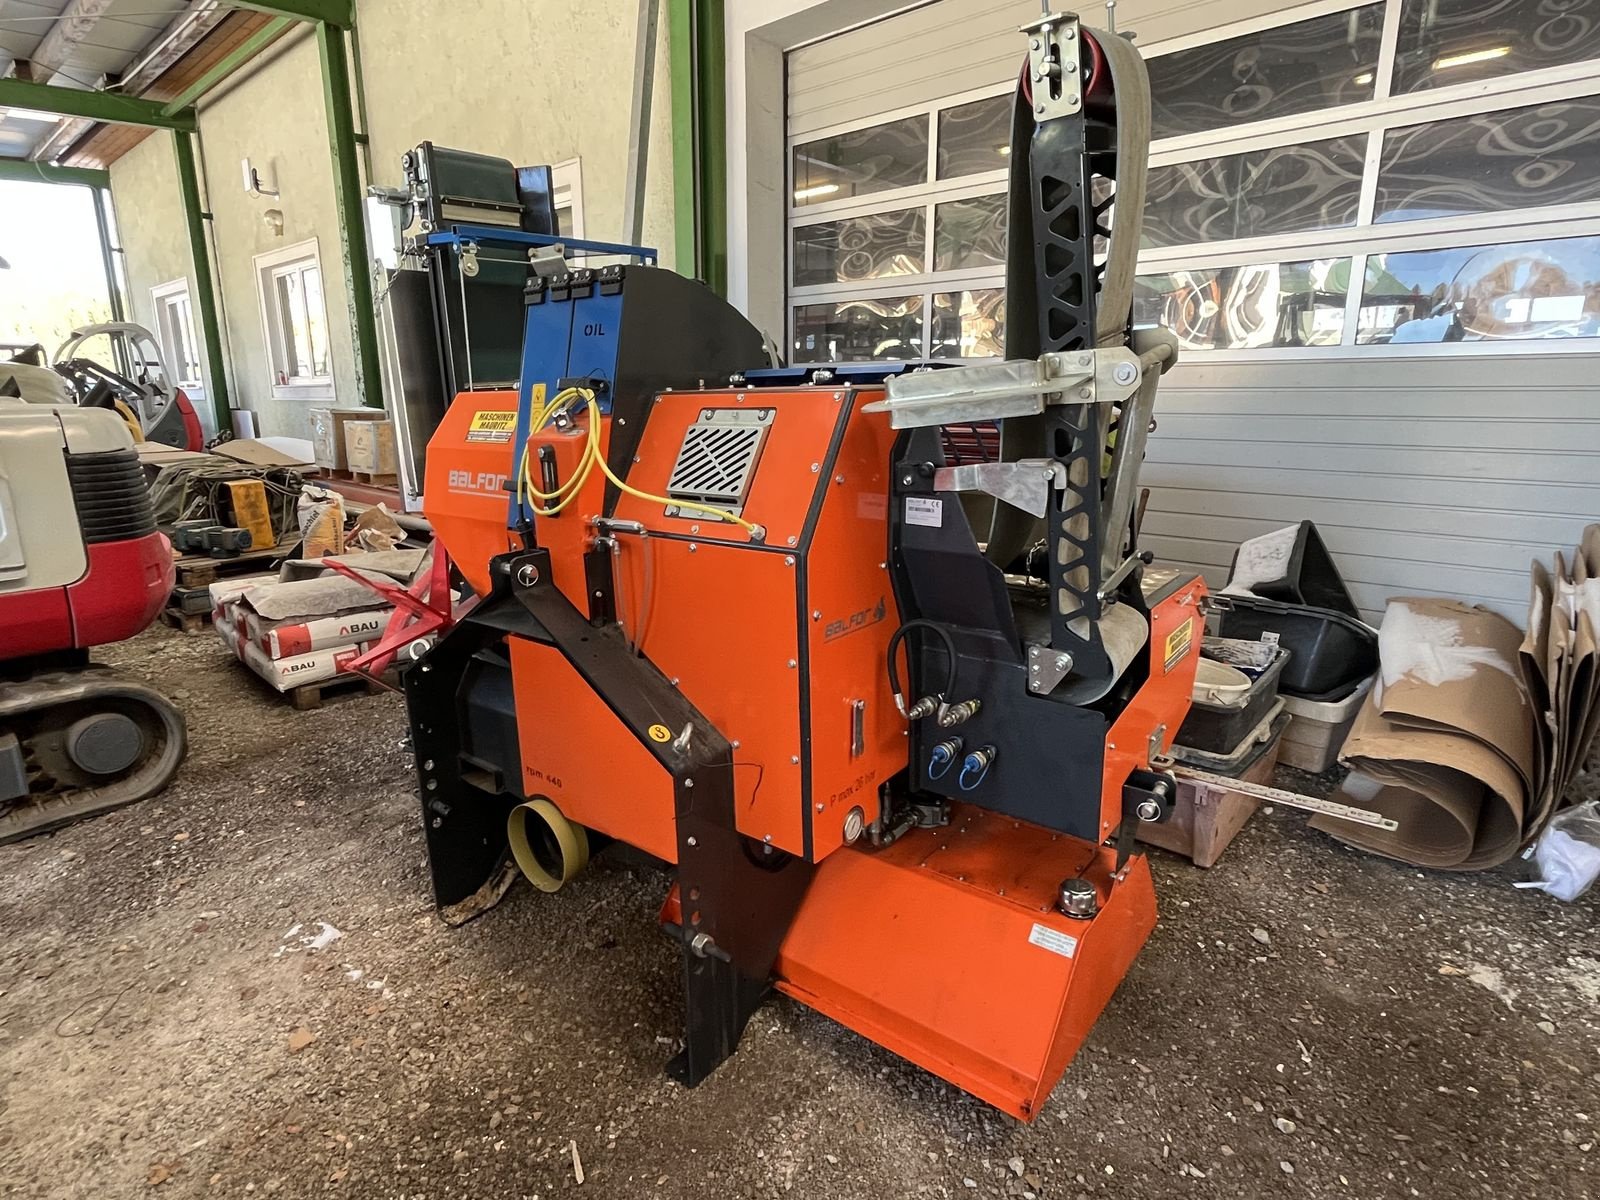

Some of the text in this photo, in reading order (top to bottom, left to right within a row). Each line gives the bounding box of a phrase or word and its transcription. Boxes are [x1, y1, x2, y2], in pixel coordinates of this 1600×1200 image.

[584, 323, 605, 337] OIL
[478, 413, 516, 422] MASCHINEN
[479, 421, 509, 431] MAURITZ
[340, 620, 379, 636] ABAU
[281, 661, 315, 675] ABAU
[526, 766, 543, 779] rpm
